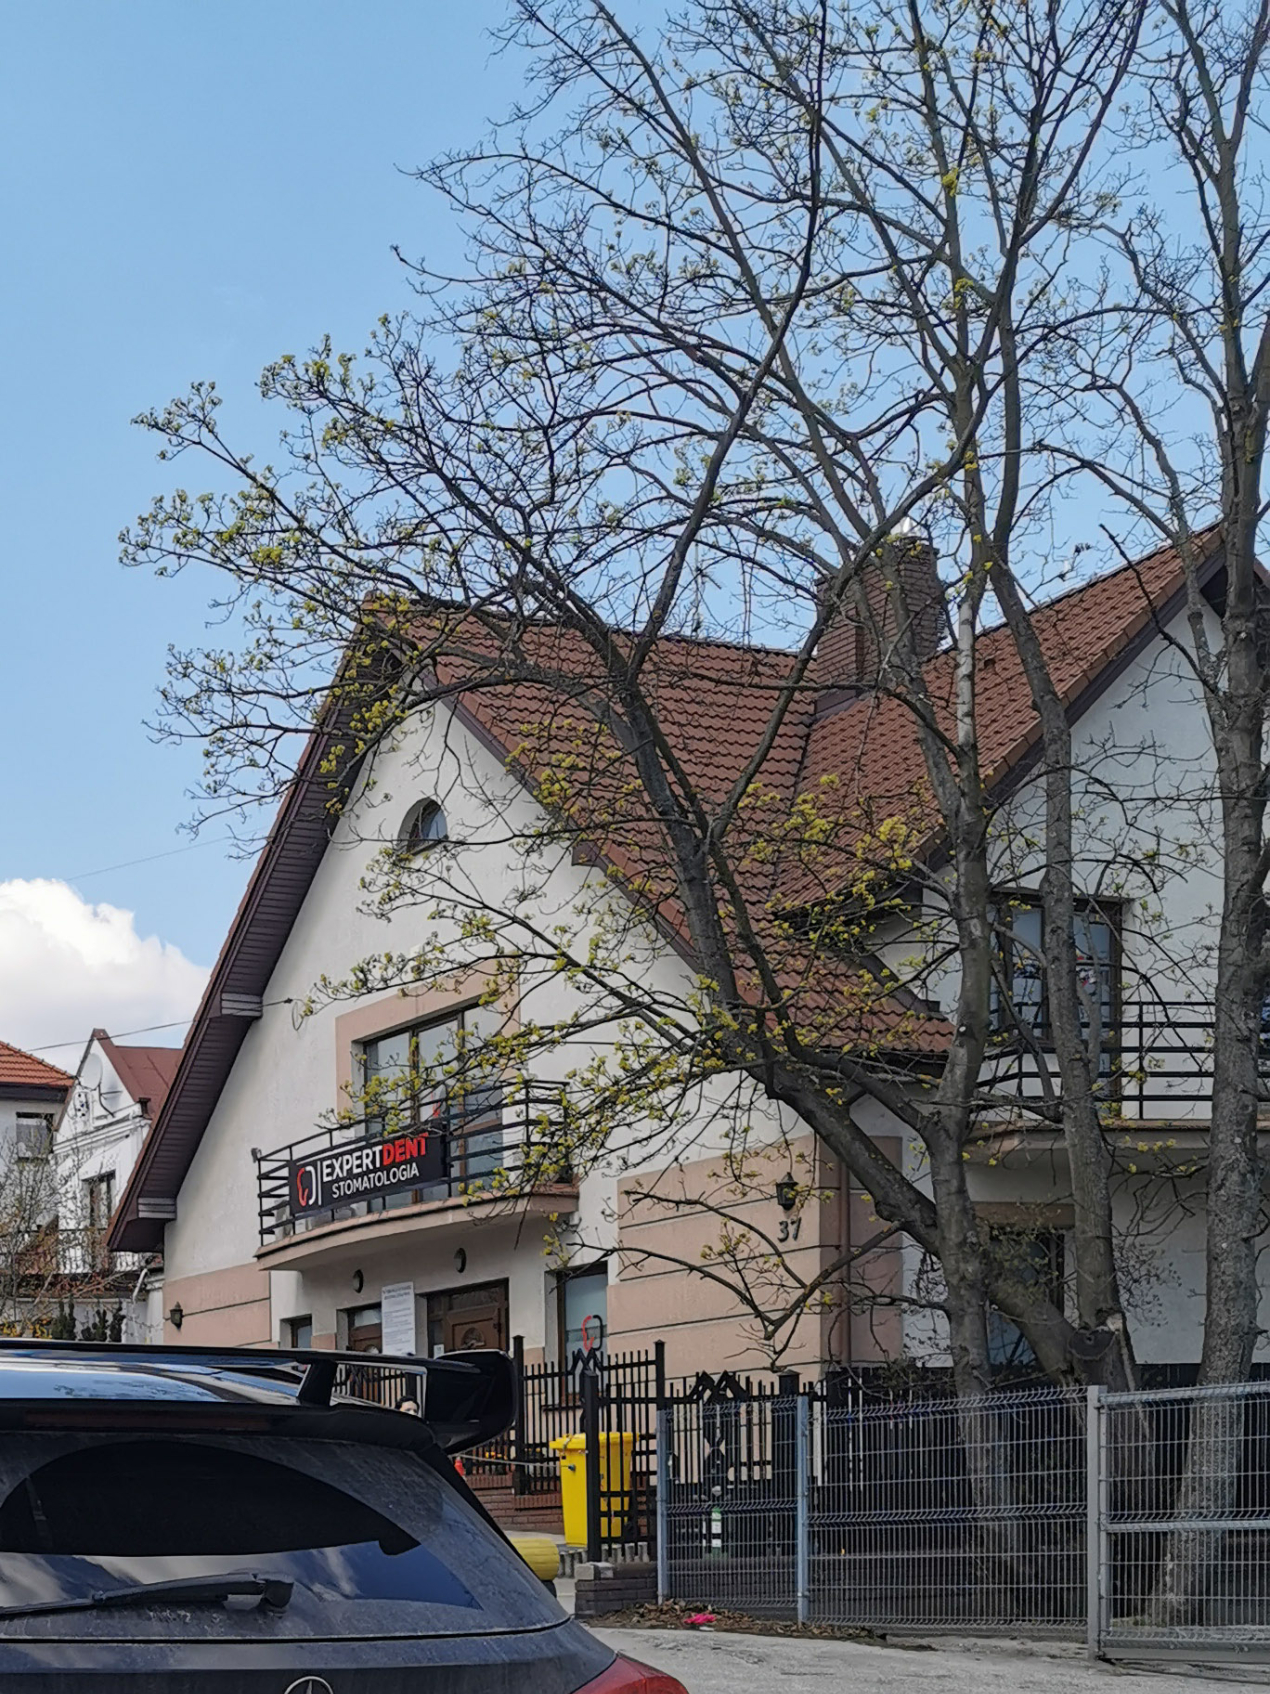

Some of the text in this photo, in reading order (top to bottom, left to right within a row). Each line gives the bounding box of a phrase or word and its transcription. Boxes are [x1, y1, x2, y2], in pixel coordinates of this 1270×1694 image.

[322, 1132, 430, 1183] EXPERTDENT
[332, 1162, 420, 1199] STOMATOLOGIA
[776, 1216, 802, 1244] 37
